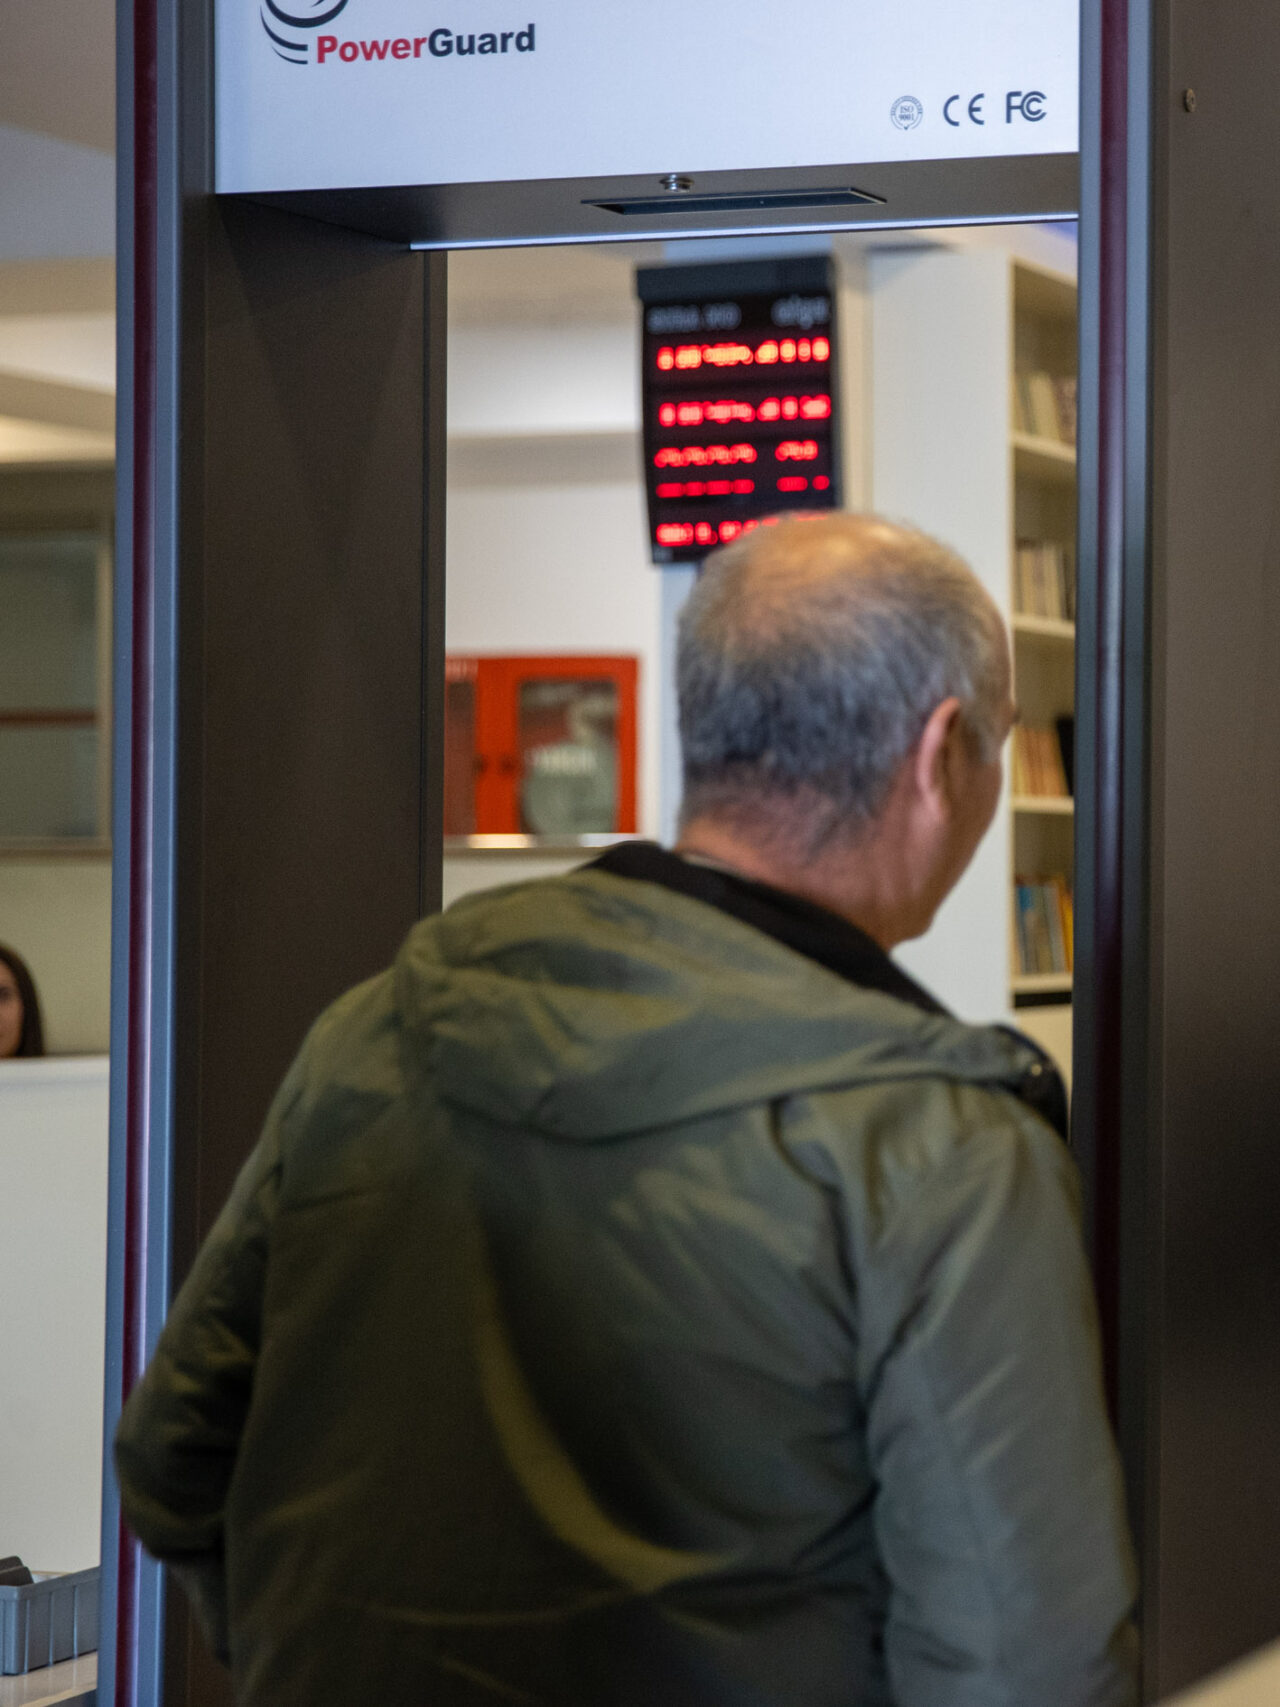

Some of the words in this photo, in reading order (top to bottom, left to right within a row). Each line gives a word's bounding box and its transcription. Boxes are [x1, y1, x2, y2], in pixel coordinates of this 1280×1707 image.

[316, 23, 536, 64] PowerGuard
[900, 105, 914, 113] ISO
[944, 93, 985, 126] CE
